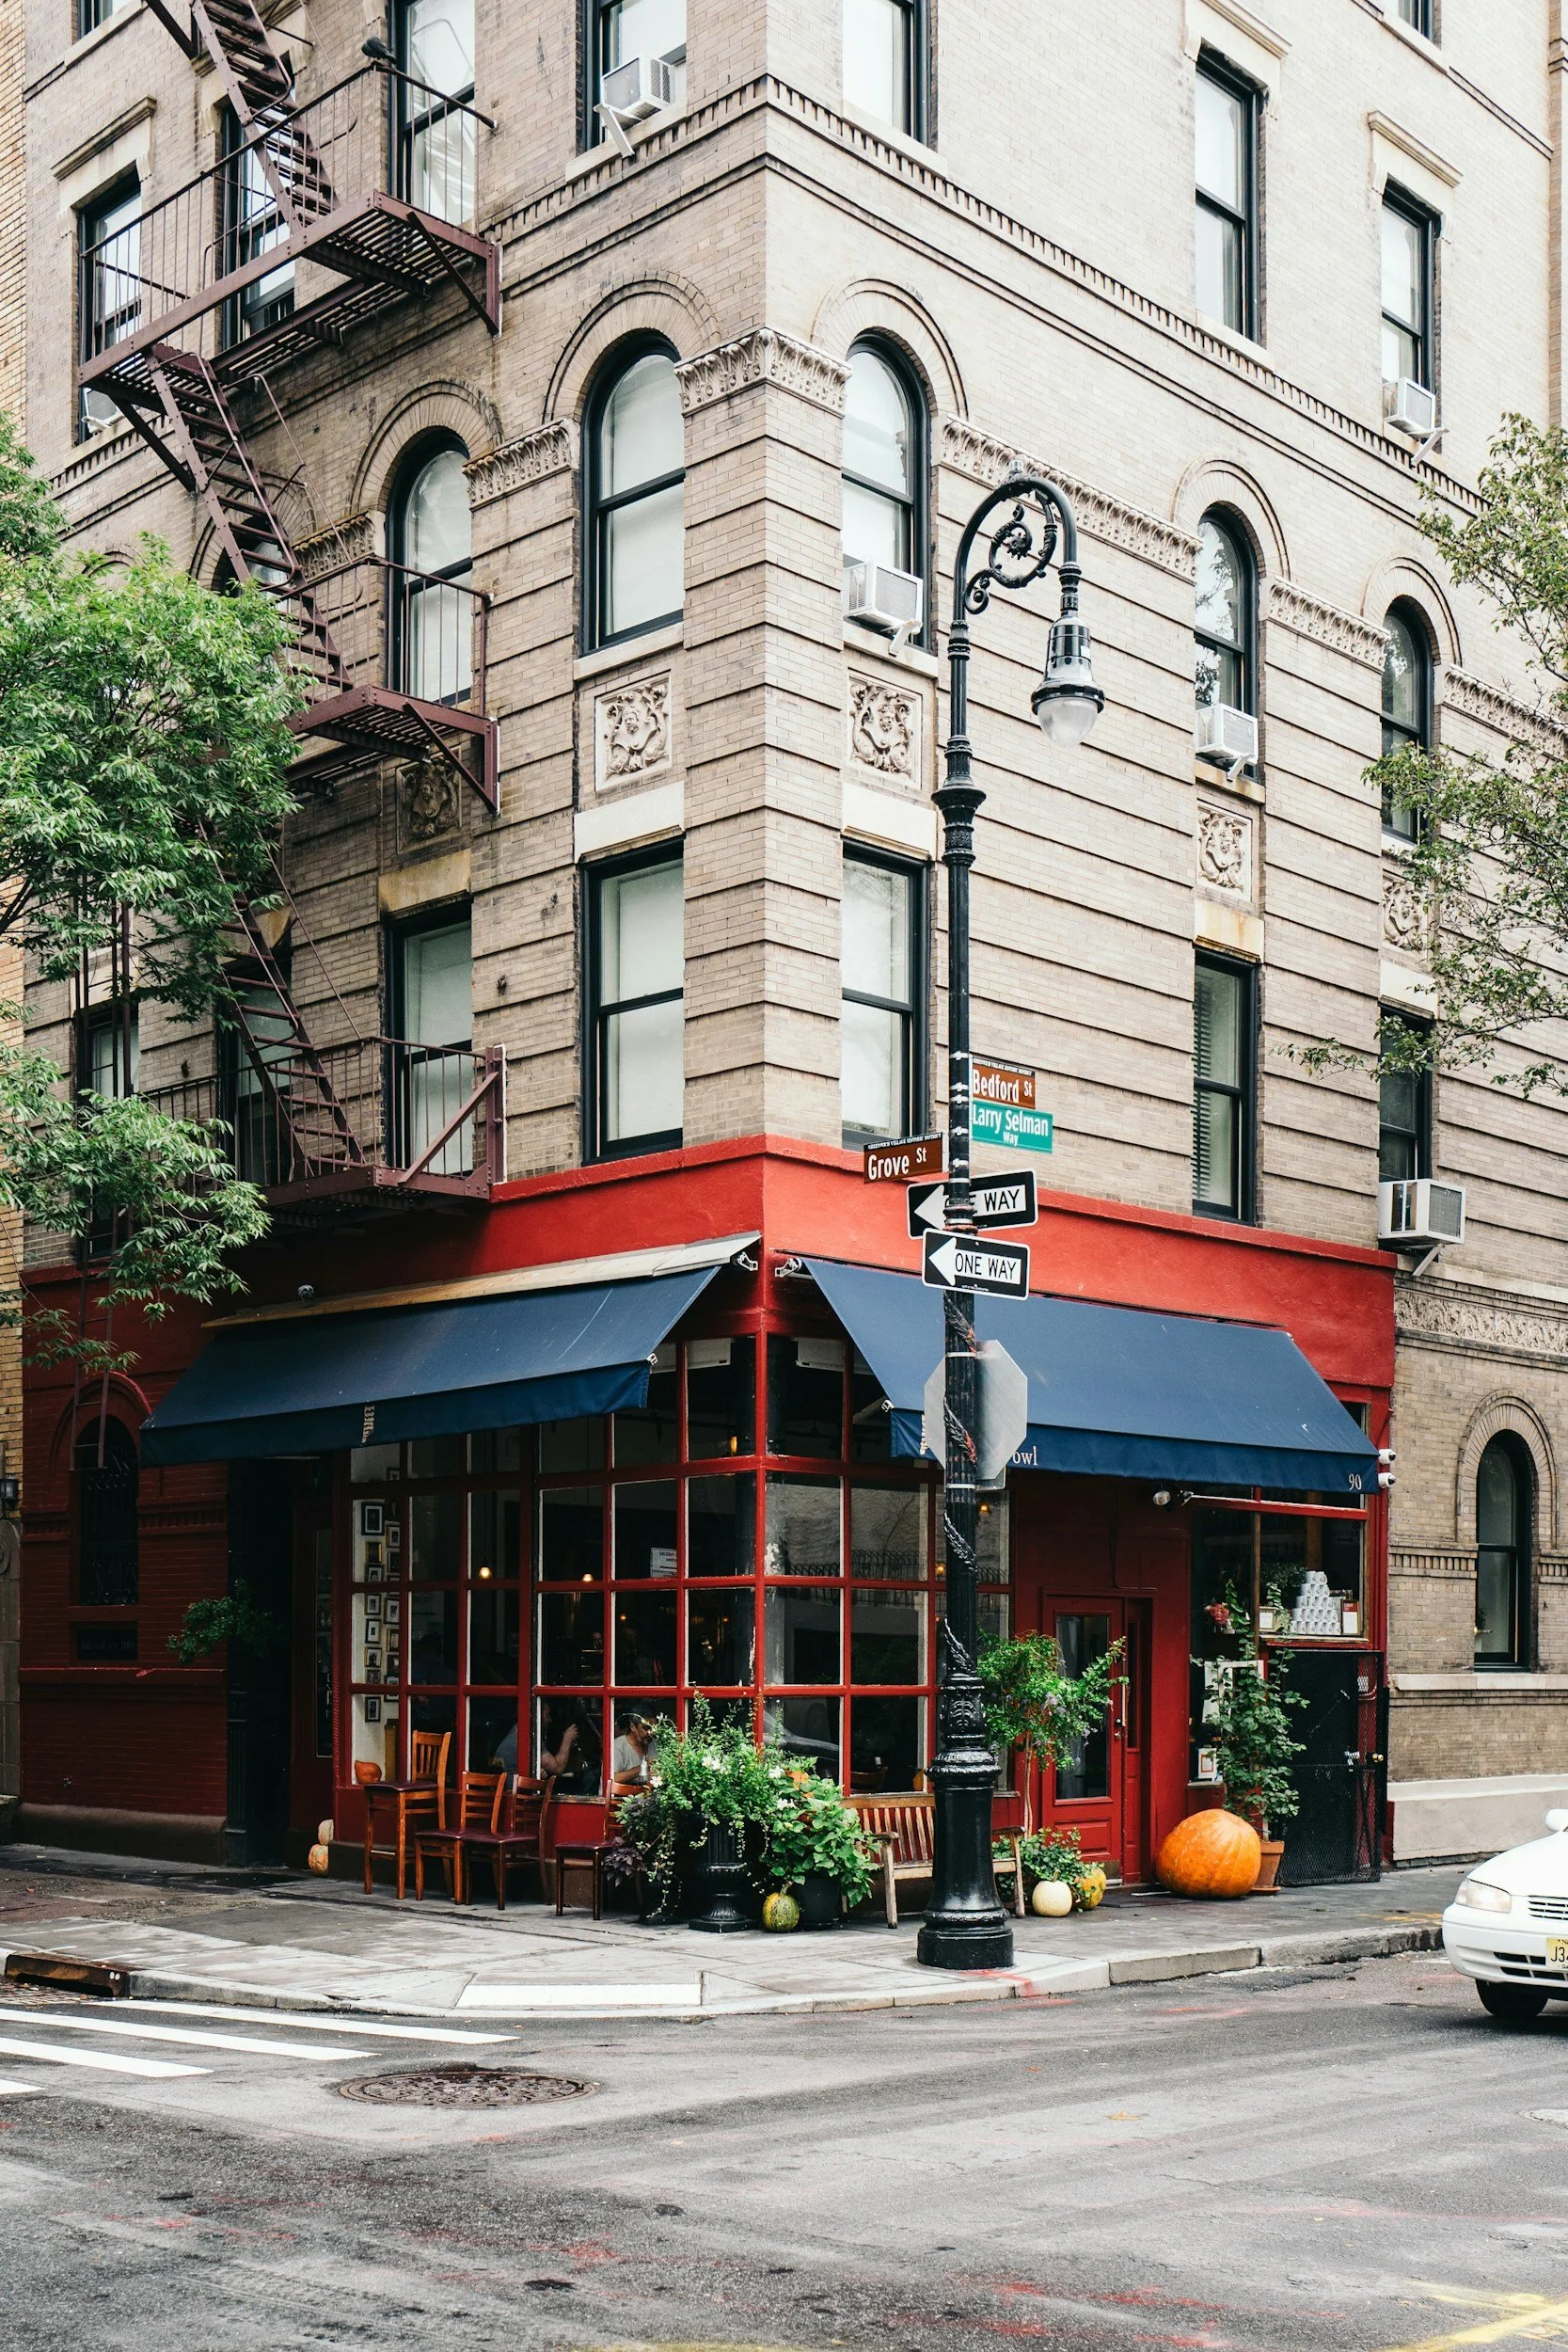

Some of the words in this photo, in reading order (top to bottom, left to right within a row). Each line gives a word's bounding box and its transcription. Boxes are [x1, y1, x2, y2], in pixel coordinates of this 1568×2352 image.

[973, 1069, 1020, 1104] Bedford
[1023, 1080, 1033, 1098] St
[973, 1104, 1002, 1135] Larry
[1005, 1110, 1049, 1136] Selman
[1003, 1131, 1019, 1147] Way
[868, 1154, 910, 1181] Grove
[916, 1147, 927, 1164] St
[984, 1189, 1020, 1212] WAY
[955, 1253, 982, 1276] ONE
[988, 1258, 1017, 1280] WAY
[1012, 1445, 1038, 1466] owl
[1348, 1473, 1362, 1491] 90
[1550, 1947, 1568, 1963] J3
